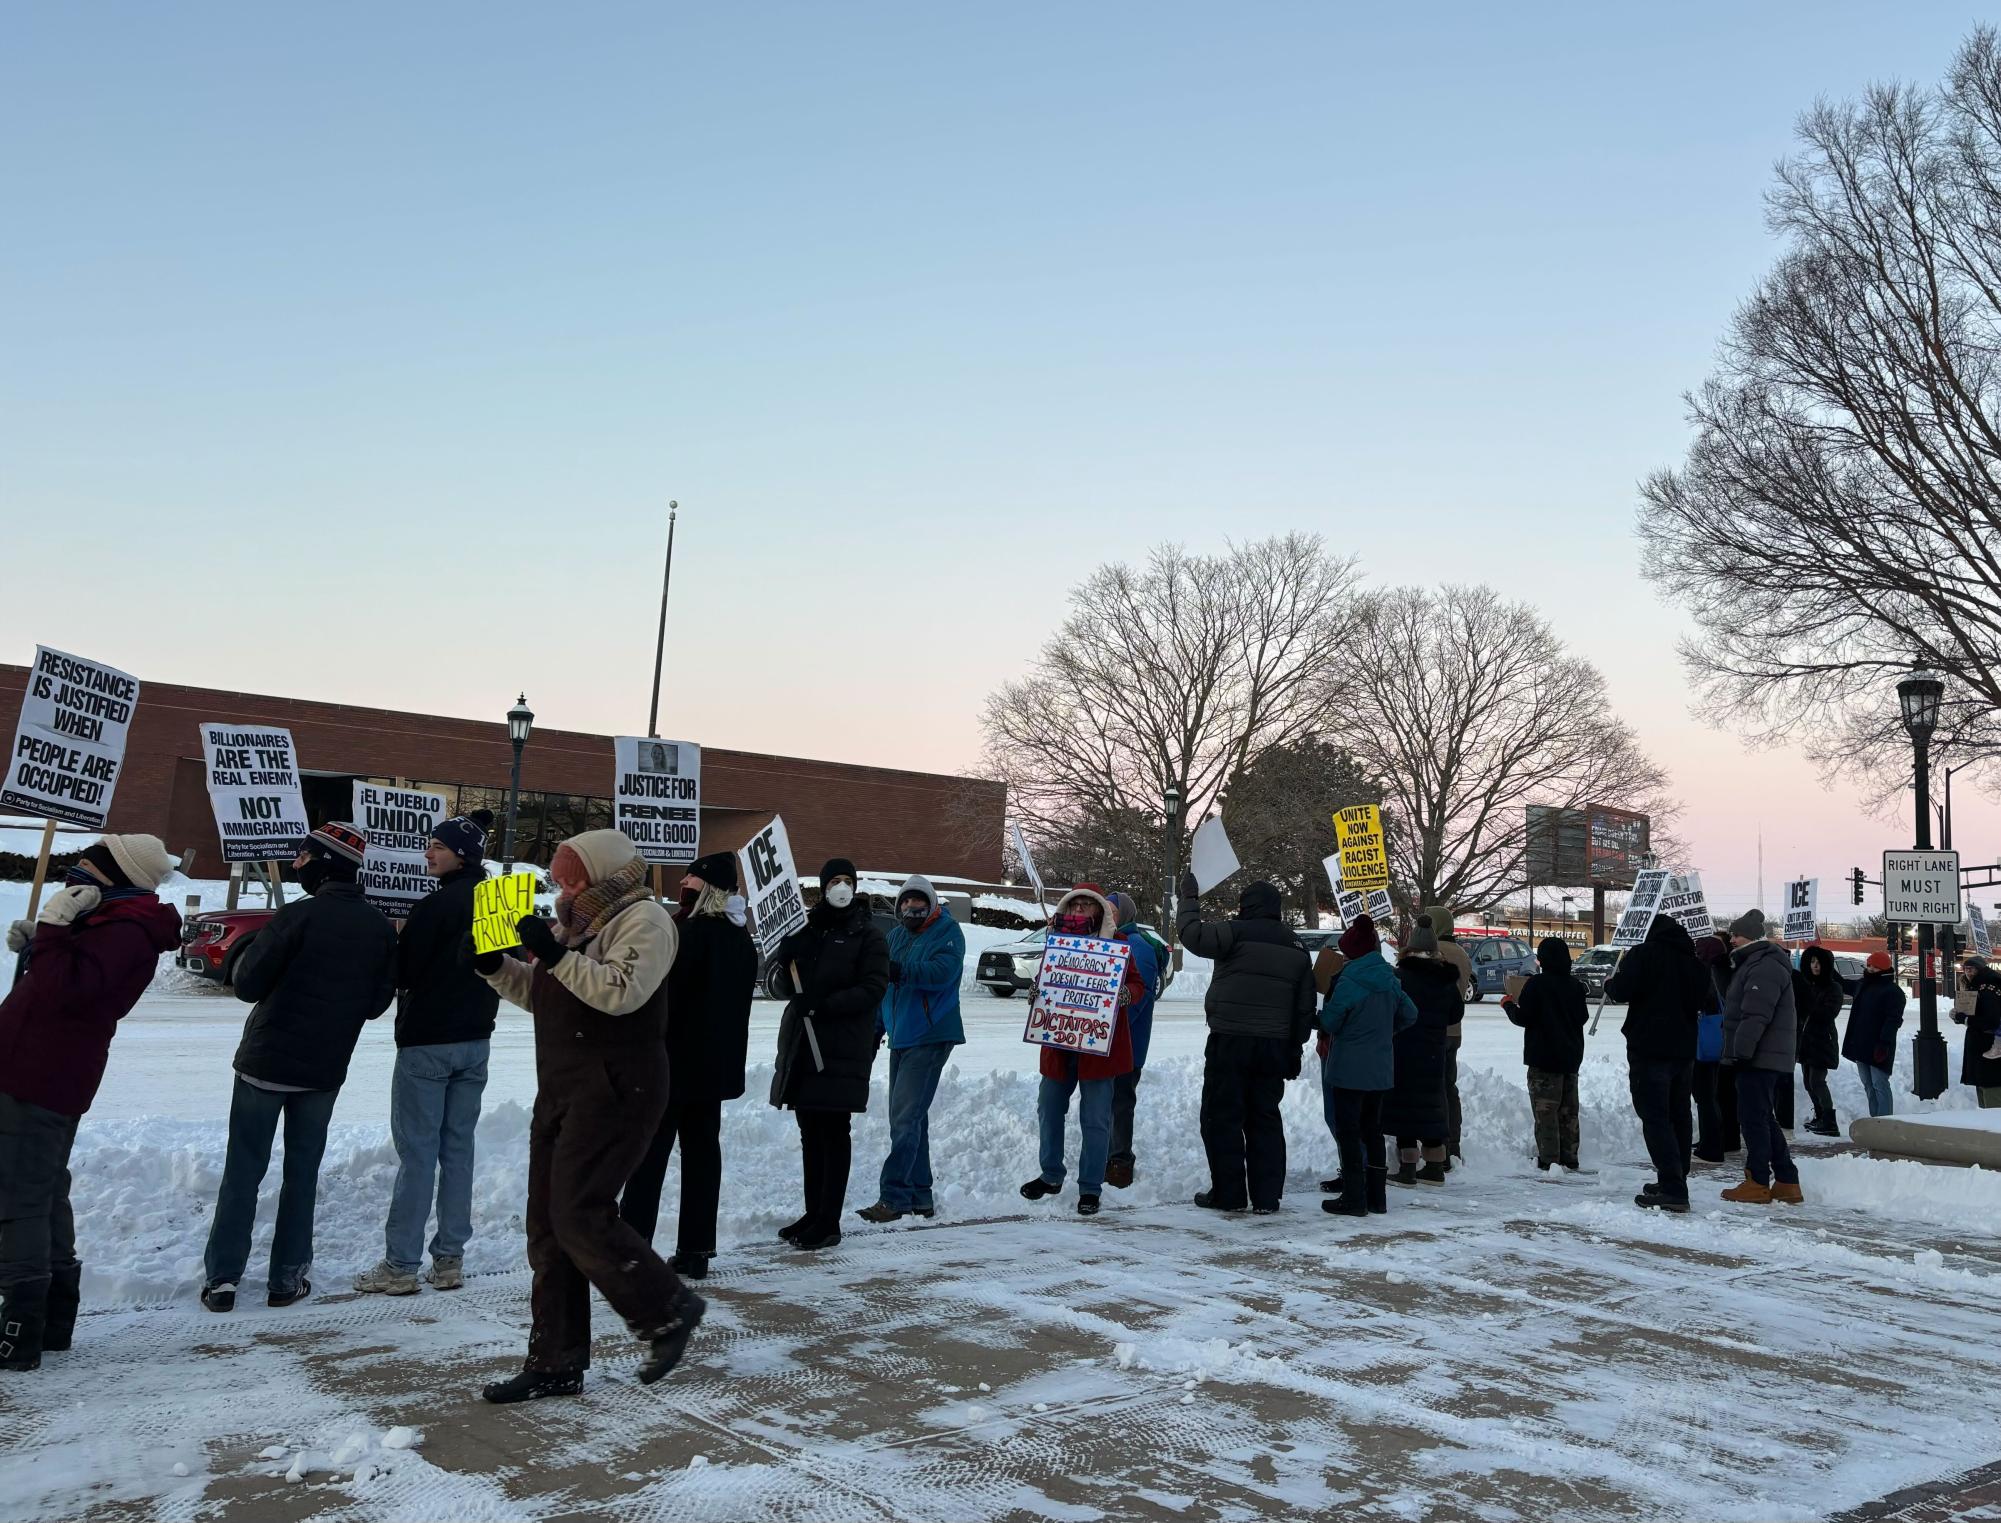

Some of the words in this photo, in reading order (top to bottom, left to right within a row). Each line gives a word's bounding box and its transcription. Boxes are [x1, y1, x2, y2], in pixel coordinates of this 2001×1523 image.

[39, 650, 136, 702] RESISTANCE
[32, 674, 53, 700] IS
[53, 683, 131, 725] JUSTIFIED
[53, 707, 104, 742] WHEN
[209, 730, 289, 748] BILLIONAIRES
[17, 734, 81, 773] PEOPLE
[80, 754, 117, 783] ARE
[215, 748, 252, 769] ARE
[255, 749, 291, 770] THE
[17, 762, 105, 806] OCCUPIED!
[212, 770, 247, 785] REAL
[249, 771, 298, 789] ENEMY,
[619, 773, 670, 799] JUSTICE
[671, 777, 696, 800] FOR
[239, 796, 282, 820] NOT
[360, 788, 380, 806] ¡EL
[384, 791, 440, 813] PUEBLO
[15, 797, 30, 807] Party
[39, 803, 64, 815] Socialism
[64, 810, 75, 818] and
[75, 812, 102, 824] Liberation
[619, 803, 697, 821] RENEE
[1340, 806, 1371, 823] UNITE
[222, 821, 306, 836] IMMIGRANTS!
[366, 805, 433, 836] UNIDO
[1347, 821, 1368, 835] NOW
[619, 820, 662, 843] NICOLE
[663, 823, 697, 844] GOOD
[1342, 833, 1379, 849] AGAINST
[227, 843, 241, 851] Party
[1345, 848, 1379, 864] RACIST
[367, 859, 387, 873] LAS
[390, 862, 429, 877] FAMILI
[747, 826, 783, 892] ICE
[1888, 859, 1920, 871] RIGHT
[1925, 860, 1954, 872] LANE
[1343, 862, 1386, 878] VIOLENCE
[1791, 881, 1810, 909] ICE
[1901, 879, 1941, 894] MUST
[378, 899, 407, 908] Socialism
[757, 896, 770, 921] OUT
[769, 889, 777, 910] OF
[776, 878, 794, 904] OUR
[1660, 894, 1688, 911] USTICE
[1687, 890, 1704, 905] FOR
[1888, 900, 1917, 912] TURN
[1923, 902, 1956, 914] RIGHT
[757, 892, 801, 941] COMMUNITIES
[1621, 910, 1652, 929] MURDER
[1666, 906, 1707, 919] ENEE
[1687, 914, 1710, 929] GOOD
[474, 910, 521, 952] TRUMP
[1508, 928, 1555, 938] STARUCKS
[1615, 927, 1647, 939] NOW!
[1058, 954, 1107, 973] DEMOCRACY
[1086, 977, 1109, 992] FEAR
[1062, 989, 1102, 1008] PROTEST
[1030, 1007, 1110, 1040] DICTATORS
[1053, 1030, 1084, 1050] DO!
